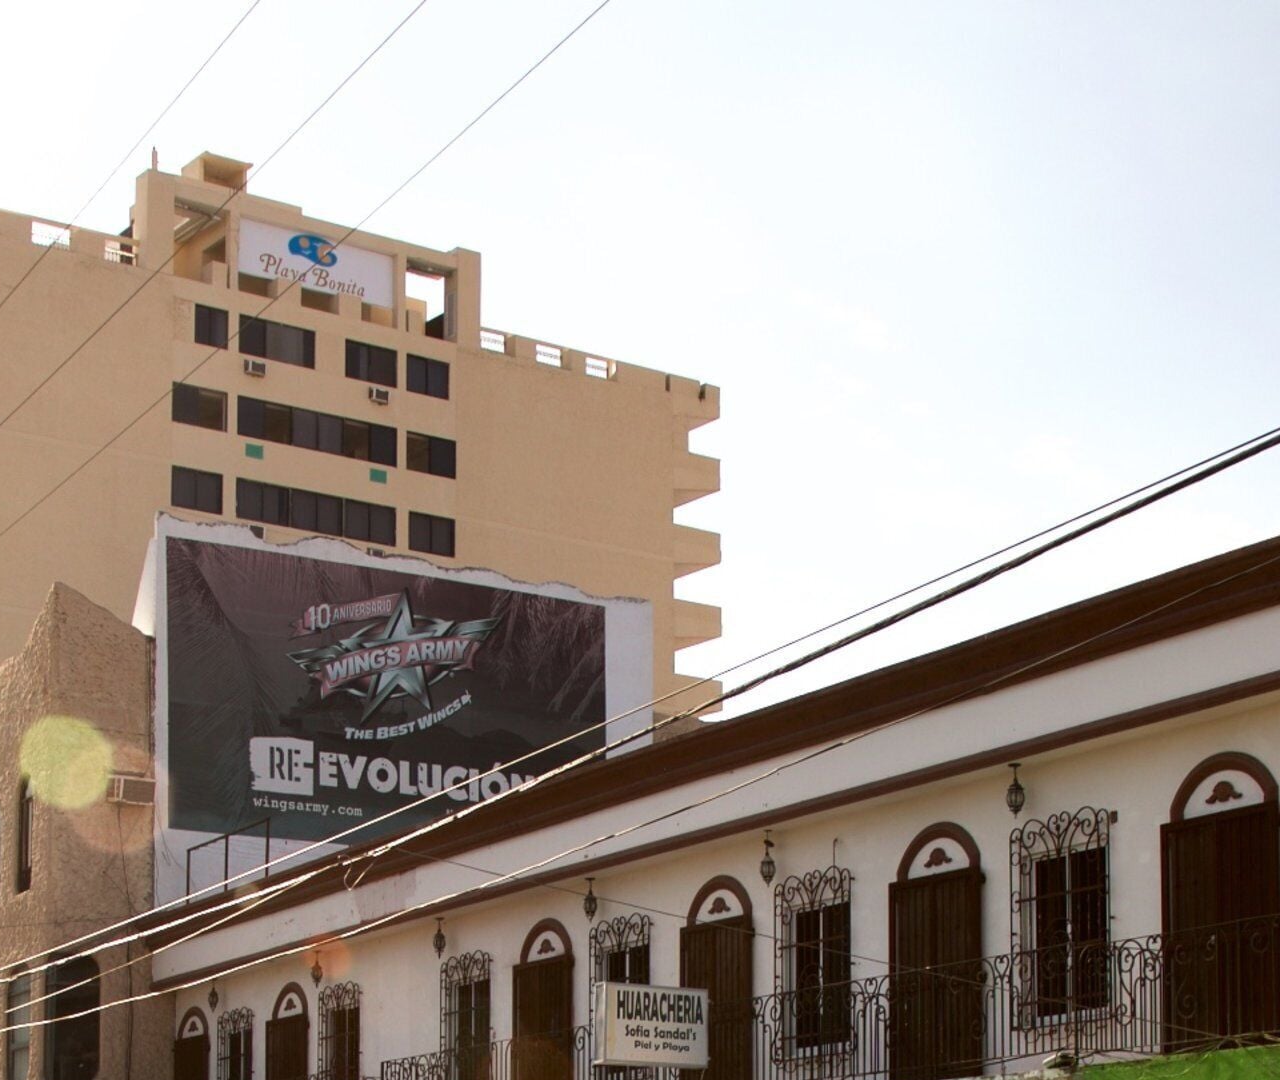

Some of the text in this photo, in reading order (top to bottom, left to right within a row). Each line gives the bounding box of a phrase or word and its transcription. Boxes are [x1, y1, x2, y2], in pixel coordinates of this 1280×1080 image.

[260, 253, 365, 297] Playa Bonita
[309, 599, 392, 631] 10 ANIVERSARIO
[406, 640, 470, 663] ARMY
[345, 701, 462, 740] THE BEST WINGS
[253, 796, 363, 817] wingsarmy.com
[617, 990, 703, 1025] HUARACHERIA
[625, 1024, 696, 1041] Sofia Sandal's
[634, 1041, 690, 1053] Piel y Playa
